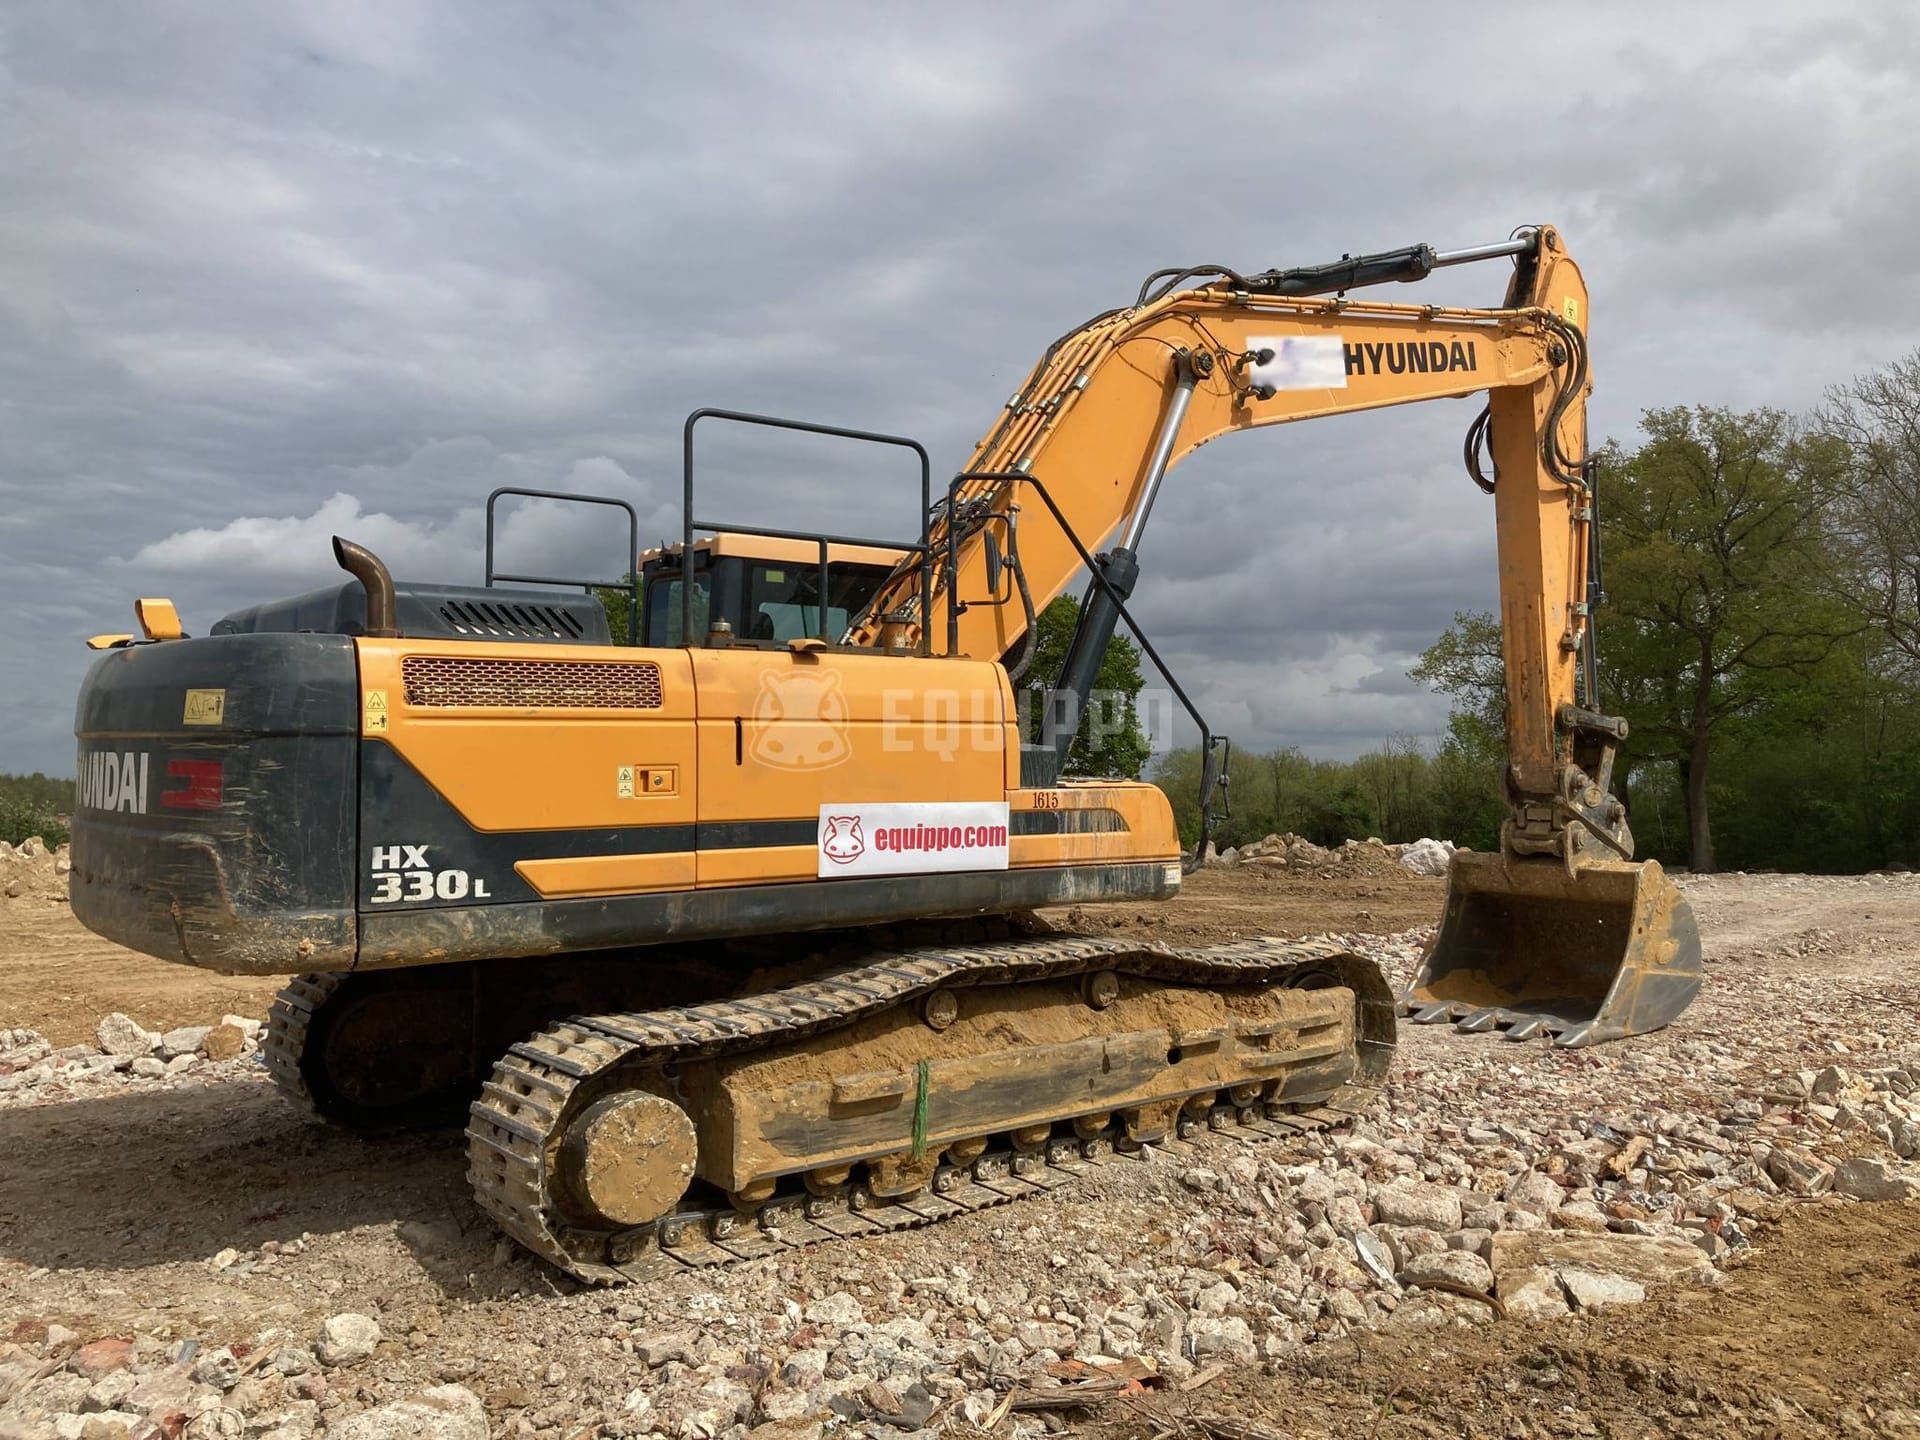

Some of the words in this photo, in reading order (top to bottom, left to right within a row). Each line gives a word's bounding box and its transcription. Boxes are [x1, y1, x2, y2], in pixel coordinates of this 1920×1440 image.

[1343, 341, 1477, 376] HYUNDAI
[1032, 791, 1059, 809] 1615
[874, 823, 1007, 853] equippo.com
[371, 844, 430, 870] HX
